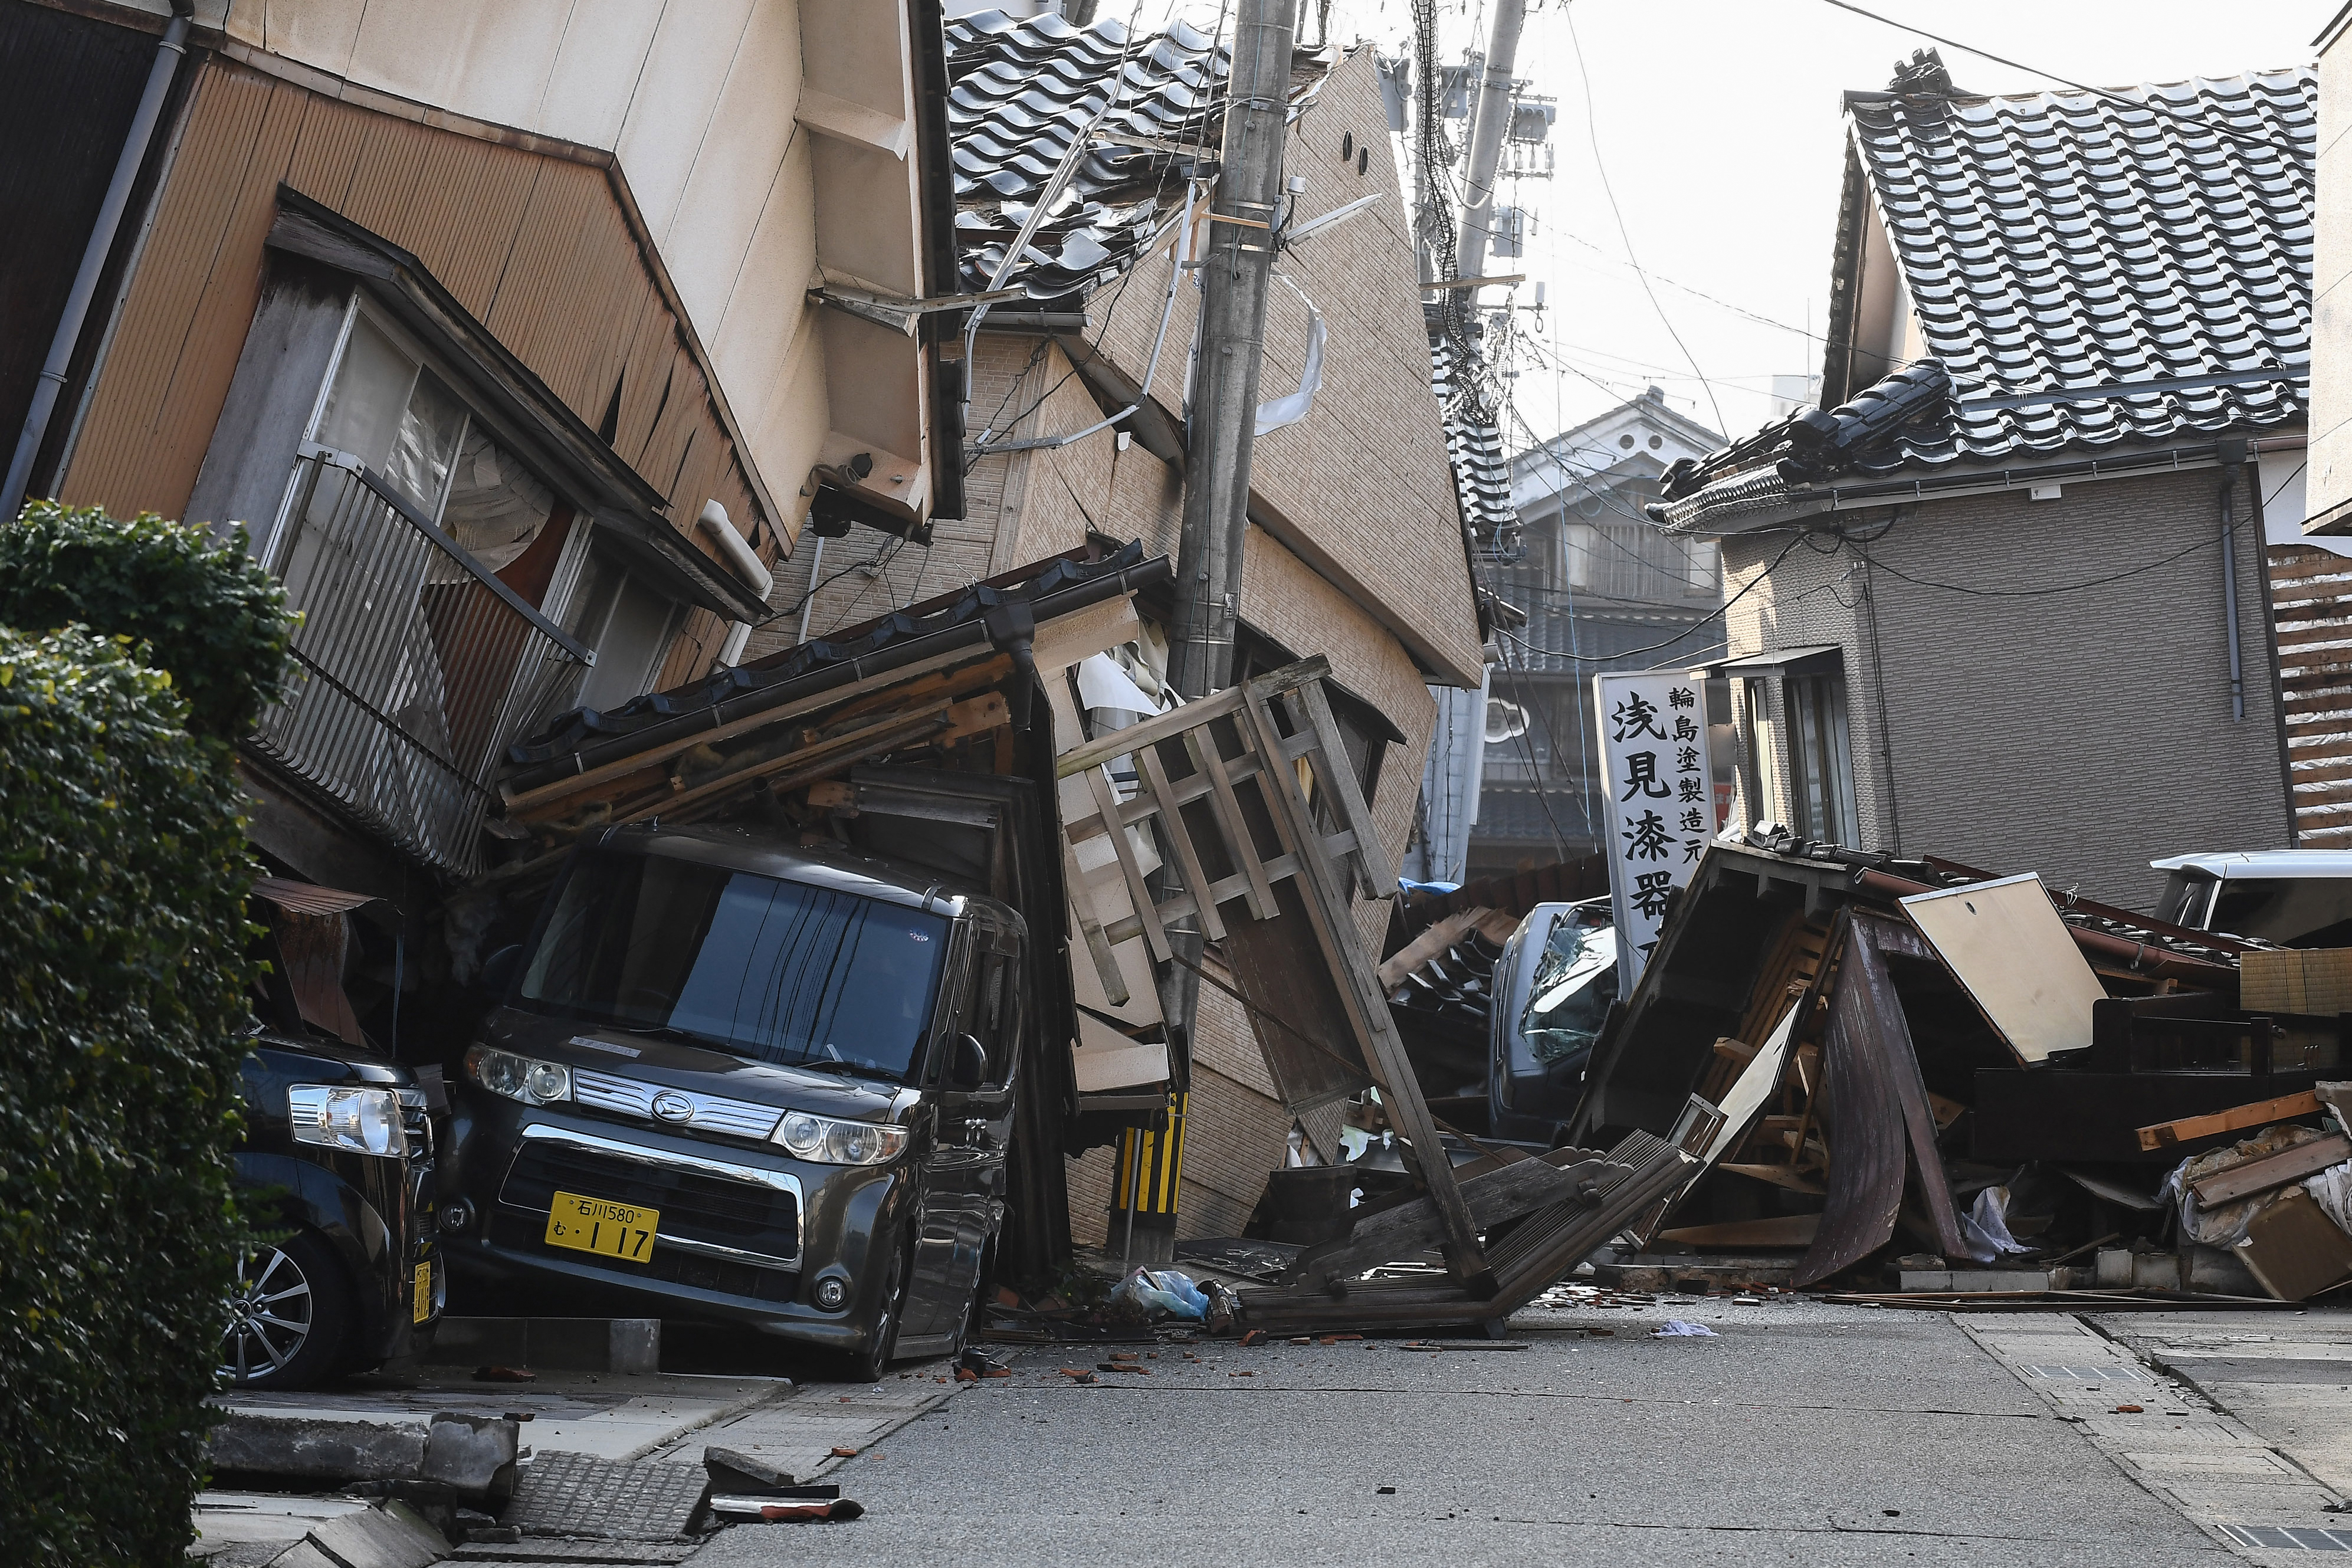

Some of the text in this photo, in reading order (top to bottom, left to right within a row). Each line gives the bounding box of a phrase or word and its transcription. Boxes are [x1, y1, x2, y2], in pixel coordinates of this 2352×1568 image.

[1668, 687, 1707, 865] 輪島塗製造元
[577, 1200, 635, 1223] 石川580
